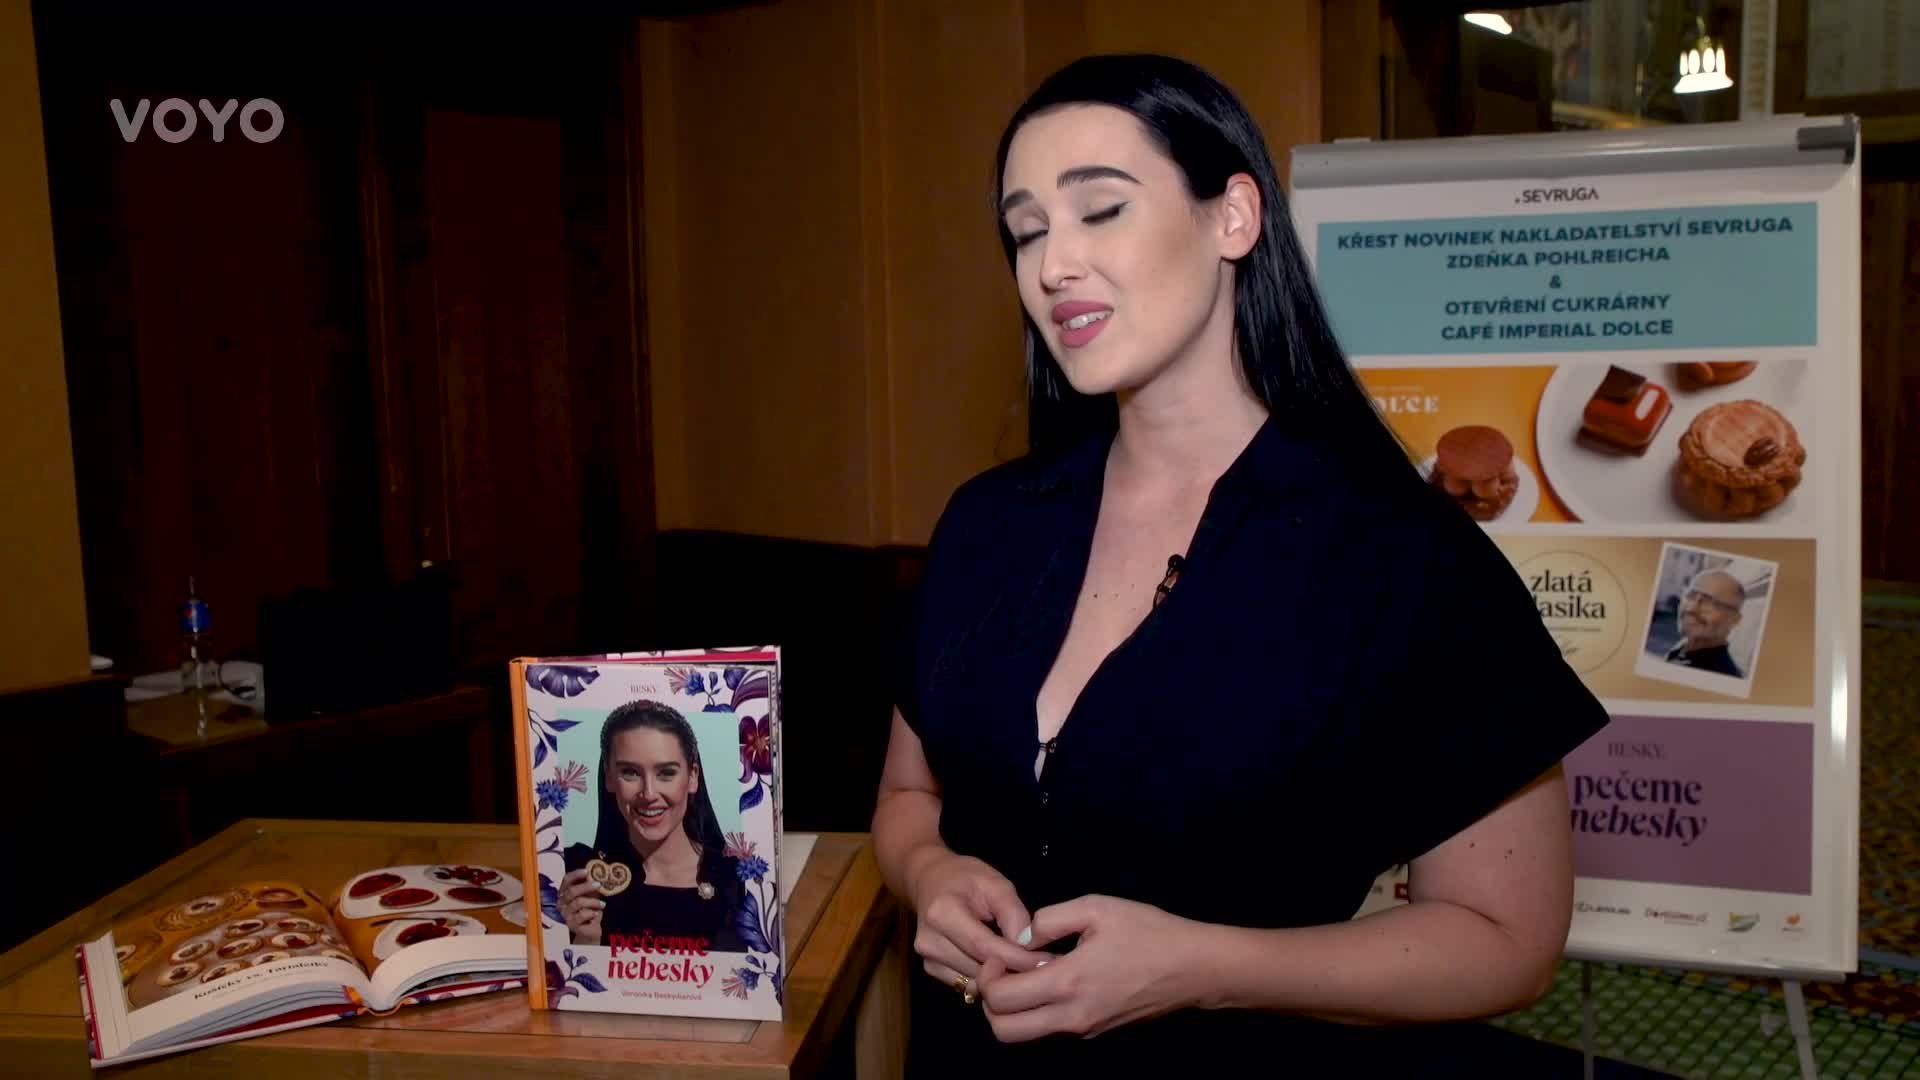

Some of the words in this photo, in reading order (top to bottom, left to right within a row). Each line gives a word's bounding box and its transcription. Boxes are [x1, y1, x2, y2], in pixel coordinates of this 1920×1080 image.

[1337, 231, 1399, 250] KŘEST
[1404, 230, 1495, 248] NOVINEK
[1500, 216, 1681, 243] NAKLADATELSTVÍ
[1687, 217, 1793, 236] SEVRUGA
[1446, 249, 1529, 270] ZDEŇKA
[1534, 247, 1670, 267] POHLREICHA
[1549, 274, 1562, 289] &
[1444, 294, 1547, 316] OTEVŘENÍ
[1551, 290, 1670, 313] CUKRÁRNY
[1441, 323, 1495, 341] CAFÉ
[1499, 322, 1597, 339] IMPERIAL
[1602, 319, 1674, 337] DOLCE
[1530, 568, 1593, 593] zlatá
[1574, 768, 1703, 806] pečeme
[1571, 804, 1707, 847] nebesky
[608, 929, 712, 958] pečeme
[607, 957, 714, 989] nebesky
